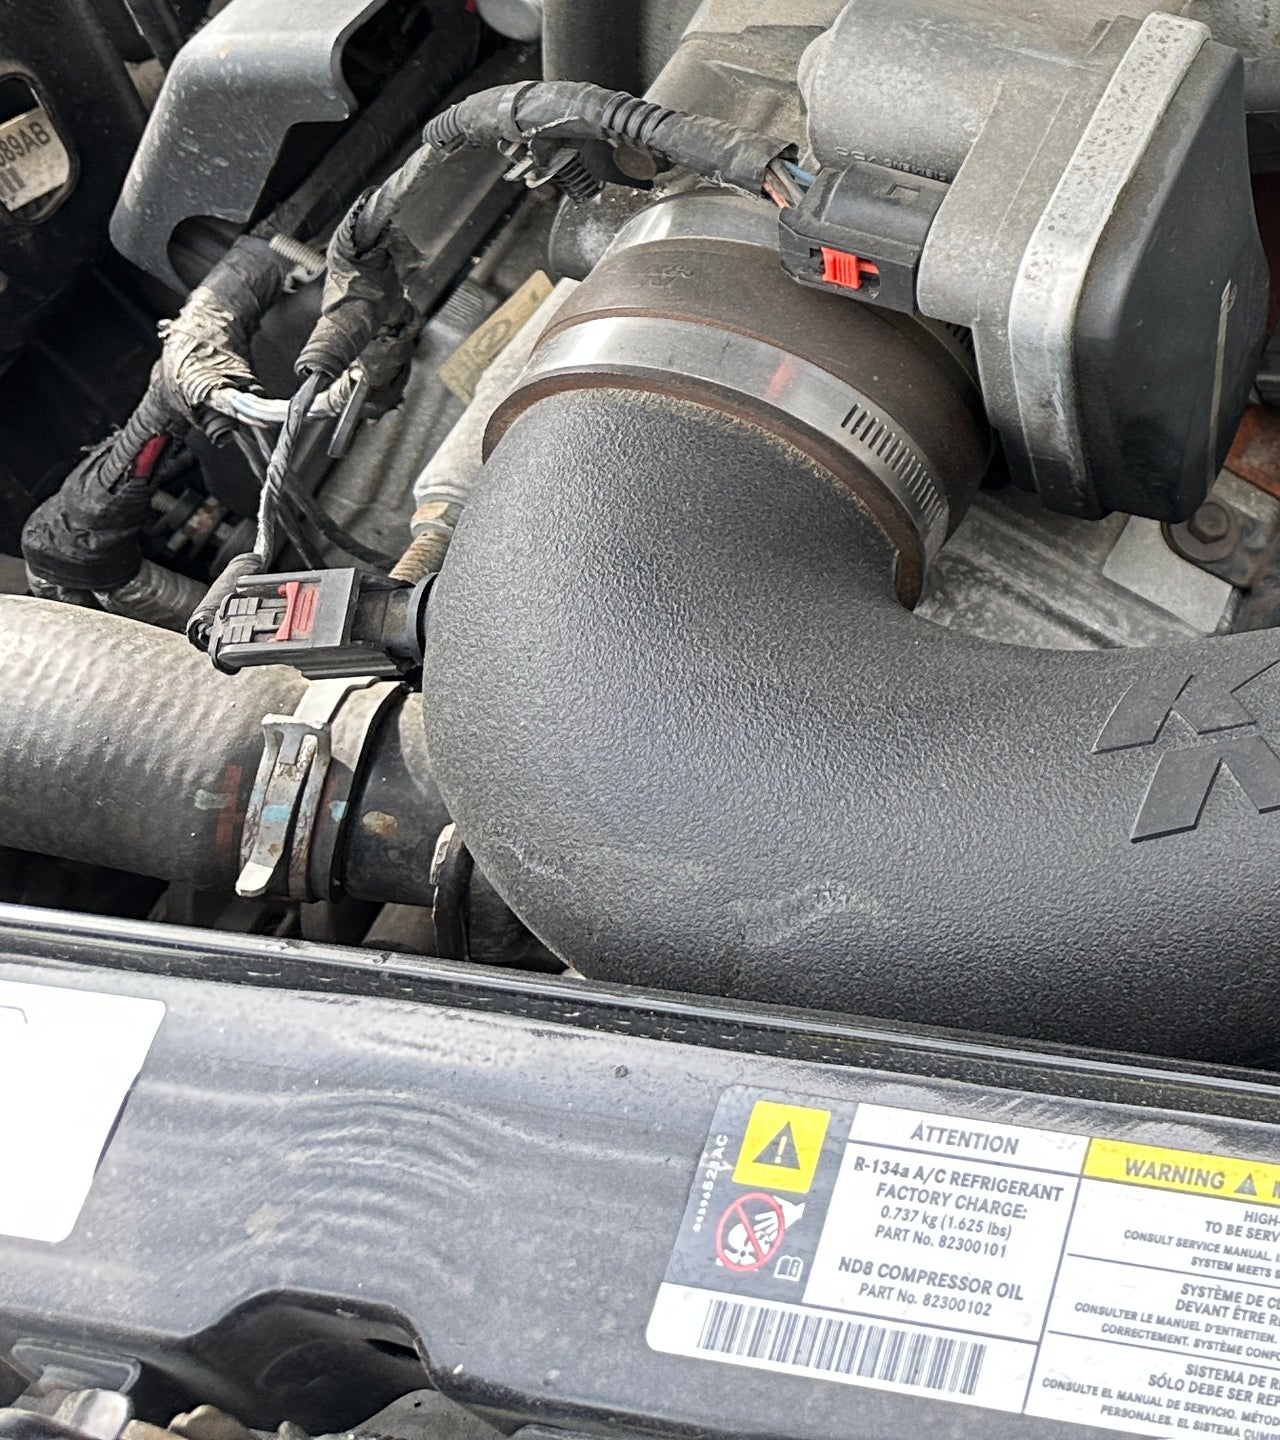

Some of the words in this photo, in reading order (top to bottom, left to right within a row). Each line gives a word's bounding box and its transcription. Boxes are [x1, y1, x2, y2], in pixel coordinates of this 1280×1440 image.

[909, 1123, 1019, 1156] ATTENTION
[853, 1155, 910, 1179] R-134a
[911, 1165, 947, 1185] A/C
[948, 1169, 1065, 1202] REFRIGERANT
[1125, 1157, 1226, 1190] WARNING
[875, 1181, 953, 1207] FACTORY
[880, 1204, 920, 1223] 0.737
[920, 1210, 939, 1230] kg
[939, 1213, 984, 1234] (1.625
[986, 1220, 1012, 1242] lbs)
[1204, 1219, 1223, 1234] TO
[1224, 1223, 1244, 1238] BE
[874, 1223, 911, 1242] PART
[937, 1234, 1007, 1258] 82300101
[1123, 1228, 1175, 1246] CONSULT
[1174, 1236, 1222, 1254] SERVICE
[837, 1255, 874, 1276] ND8
[876, 1262, 993, 1296] COMPRESSOR
[995, 1281, 1024, 1301] OIL
[1190, 1255, 1234, 1272] SYSTEM
[1235, 1262, 1273, 1278] MEETS
[857, 1281, 896, 1301] PART
[921, 1292, 993, 1317] 82300102
[1179, 1282, 1244, 1304] SYSTÈME
[1244, 1292, 1265, 1308] DE
[1074, 1301, 1138, 1321] CONSULTER
[1139, 1312, 1154, 1324] LE
[1154, 1314, 1202, 1332] MANUEL
[1174, 1297, 1231, 1319] DEVANT
[1231, 1304, 1267, 1325] ÊTRE
[1192, 1337, 1244, 1356] SYSTÈME
[1147, 1372, 1186, 1392] SÓLO
[1187, 1380, 1225, 1398] DEBE
[1225, 1386, 1254, 1403] SER
[1184, 1362, 1244, 1385] SISTEMA
[1246, 1372, 1268, 1389] DE
[1041, 1376, 1099, 1397] CONSULTE
[1100, 1386, 1114, 1399] EL
[1115, 1389, 1164, 1408] MANUAL
[1165, 1397, 1182, 1411] DE
[1176, 1416, 1190, 1429] EL
[1191, 1419, 1241, 1438] SISTEMA
